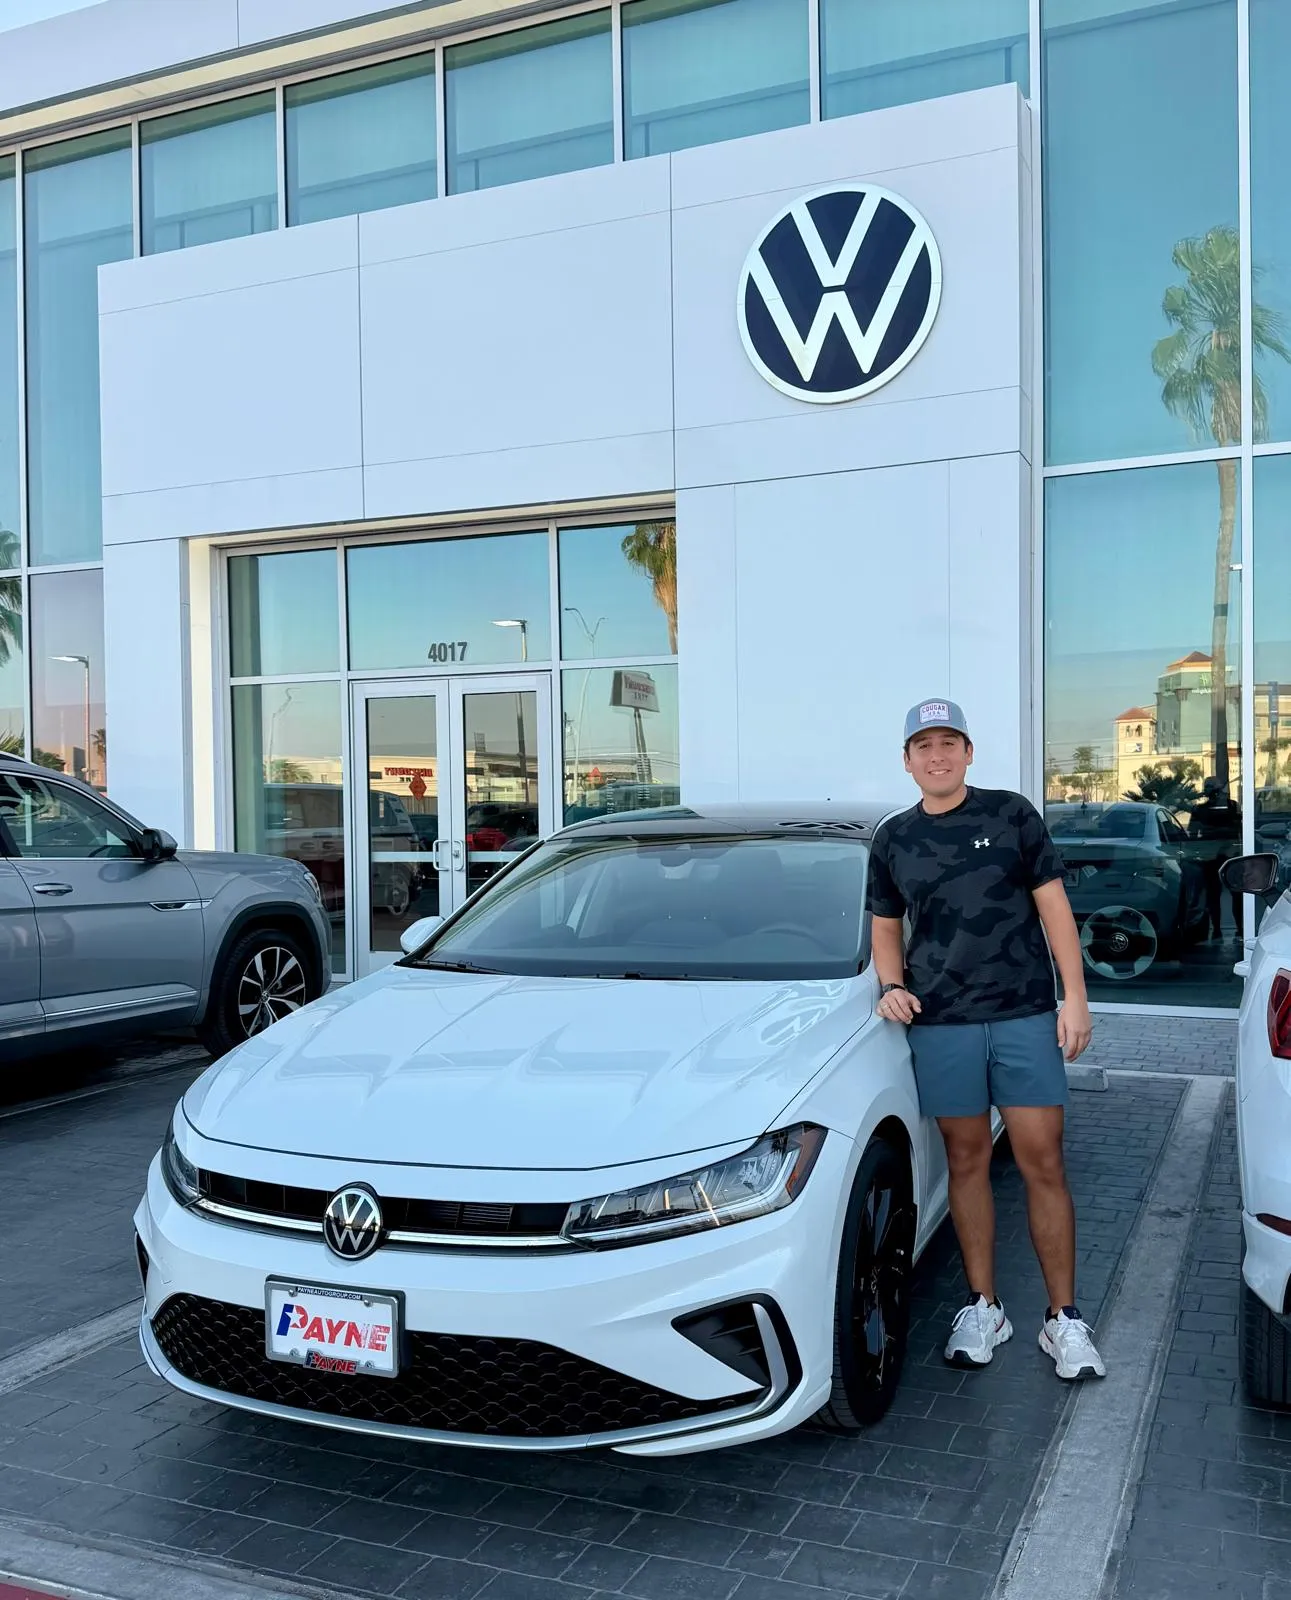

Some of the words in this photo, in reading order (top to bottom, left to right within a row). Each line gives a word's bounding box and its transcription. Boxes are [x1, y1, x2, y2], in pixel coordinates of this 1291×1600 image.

[741, 186, 939, 398] VW
[428, 641, 467, 662] 4017
[922, 704, 946, 713] COUGAR
[325, 1188, 381, 1257] VW
[297, 1287, 361, 1300] PAYNEAUTOGROUP.COM
[276, 1303, 391, 1352] PAYNE
[305, 1351, 357, 1373] PAYNE
